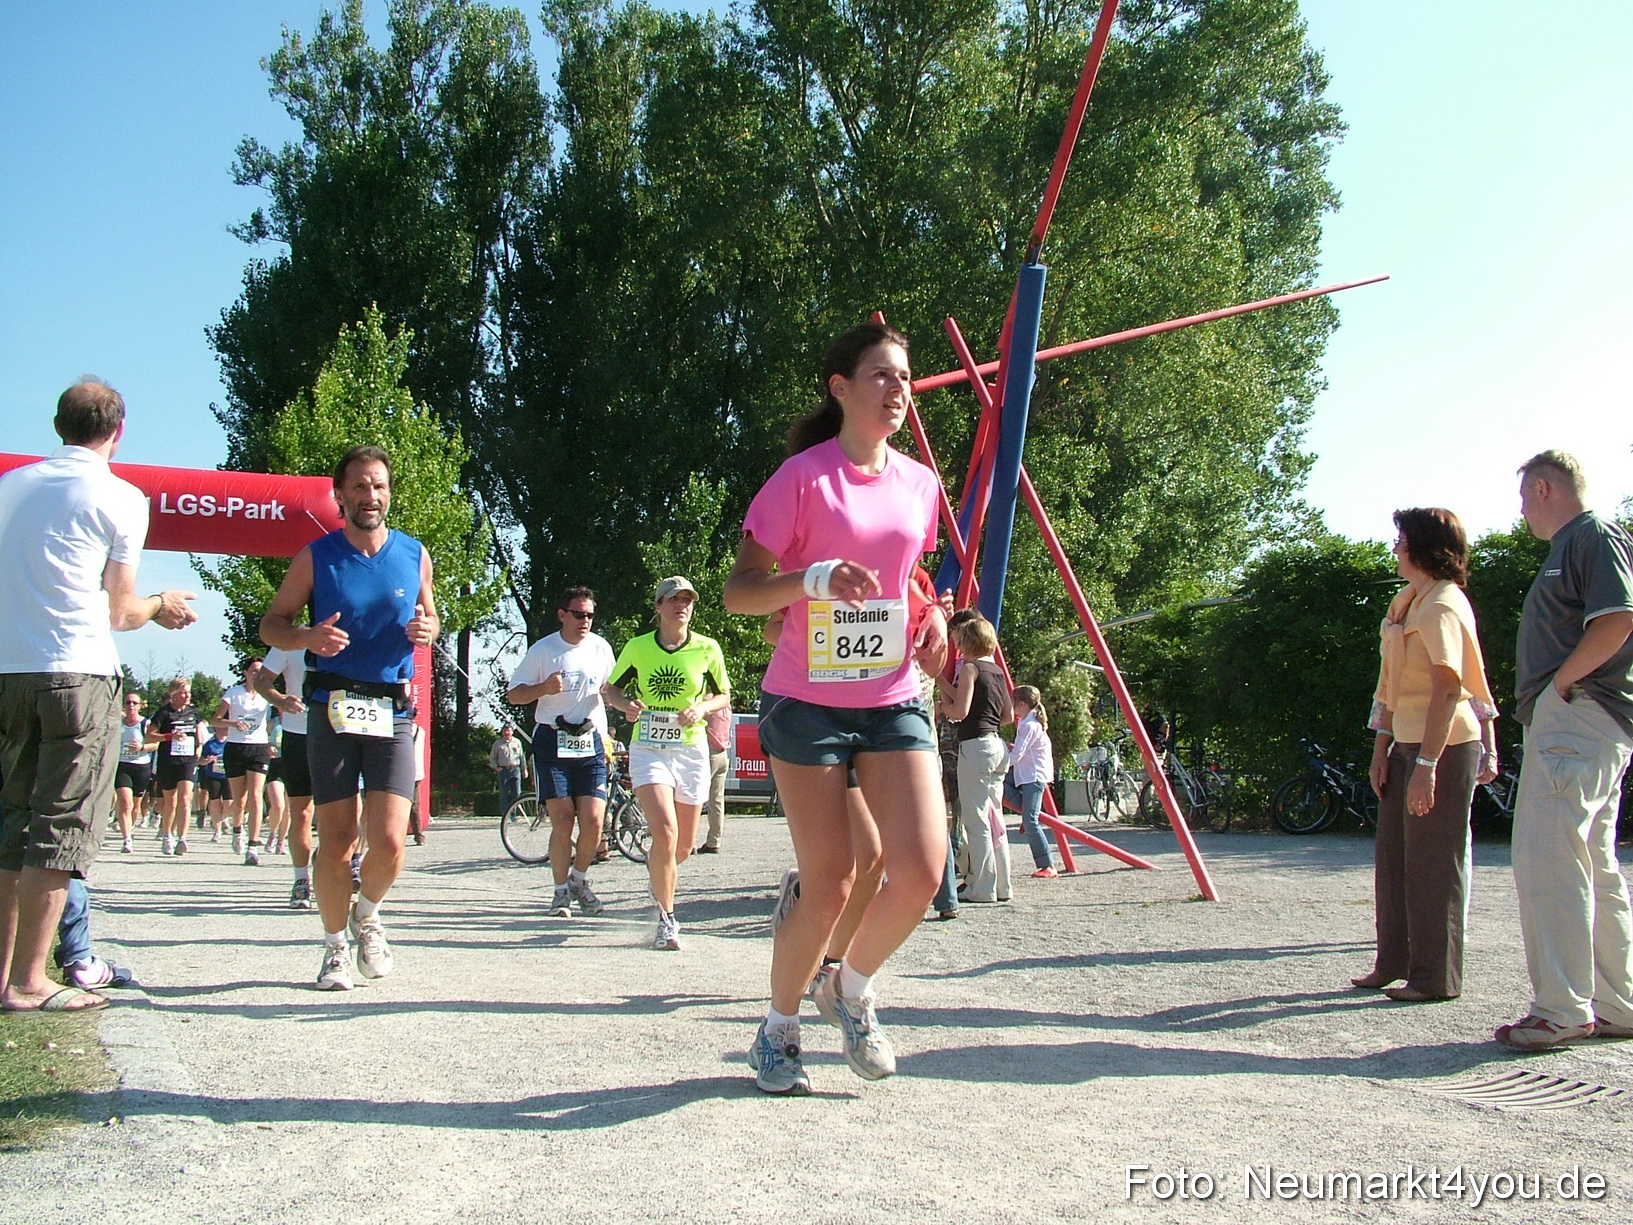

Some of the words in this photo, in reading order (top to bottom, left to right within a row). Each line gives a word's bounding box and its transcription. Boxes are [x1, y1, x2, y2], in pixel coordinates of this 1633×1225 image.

[160, 492, 286, 521] LGS-Park
[833, 608, 889, 624] Stefanie
[814, 632, 825, 644] C
[836, 634, 884, 659] 842
[648, 677, 686, 685] POWER
[332, 702, 339, 710] C
[346, 705, 378, 722] 235
[651, 715, 669, 724] Tanja
[651, 727, 682, 740] 2759
[567, 739, 592, 750] 2984
[735, 757, 766, 772] Braun
